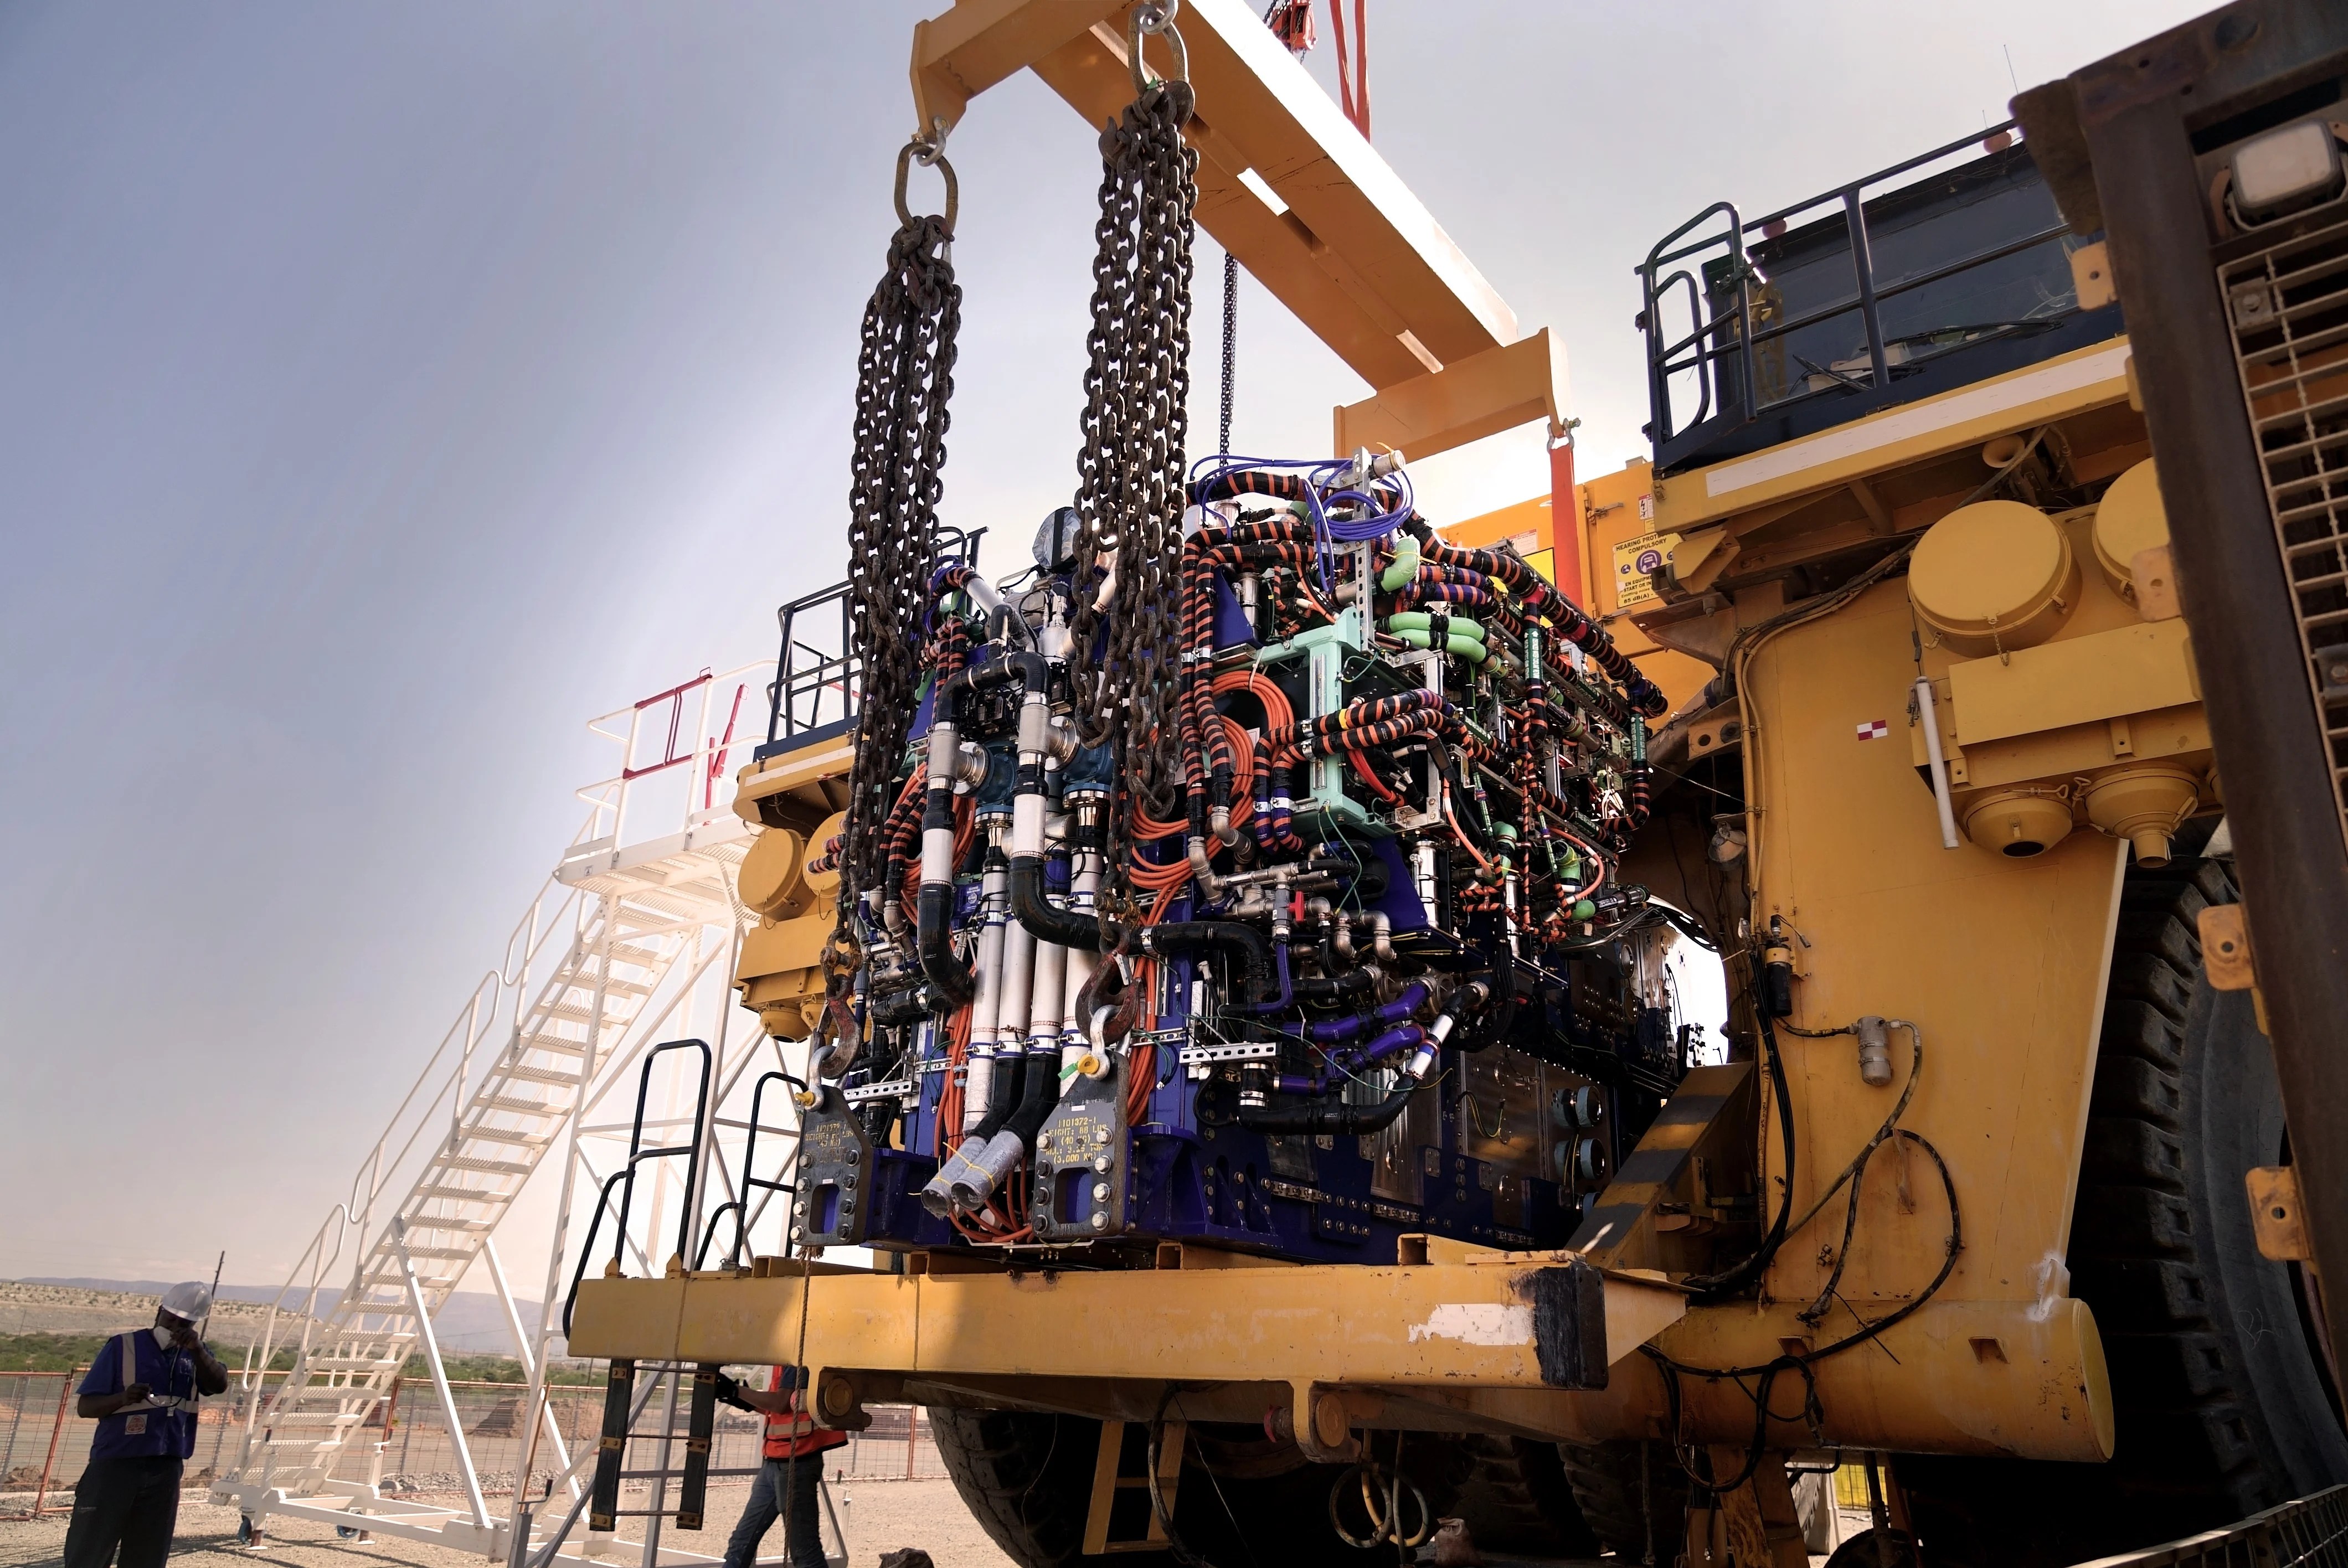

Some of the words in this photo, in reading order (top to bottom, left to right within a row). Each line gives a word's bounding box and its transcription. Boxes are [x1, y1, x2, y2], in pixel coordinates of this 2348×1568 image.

[1616, 539, 1641, 551] HEARING
[1628, 538, 1667, 554] COMPULSORY
[1633, 593, 1649, 601] dB(A)
[1058, 1116, 1096, 1128] 1101372-1
[1061, 1136, 1073, 1146] (40
[1054, 1153, 1079, 1164] (3,000
